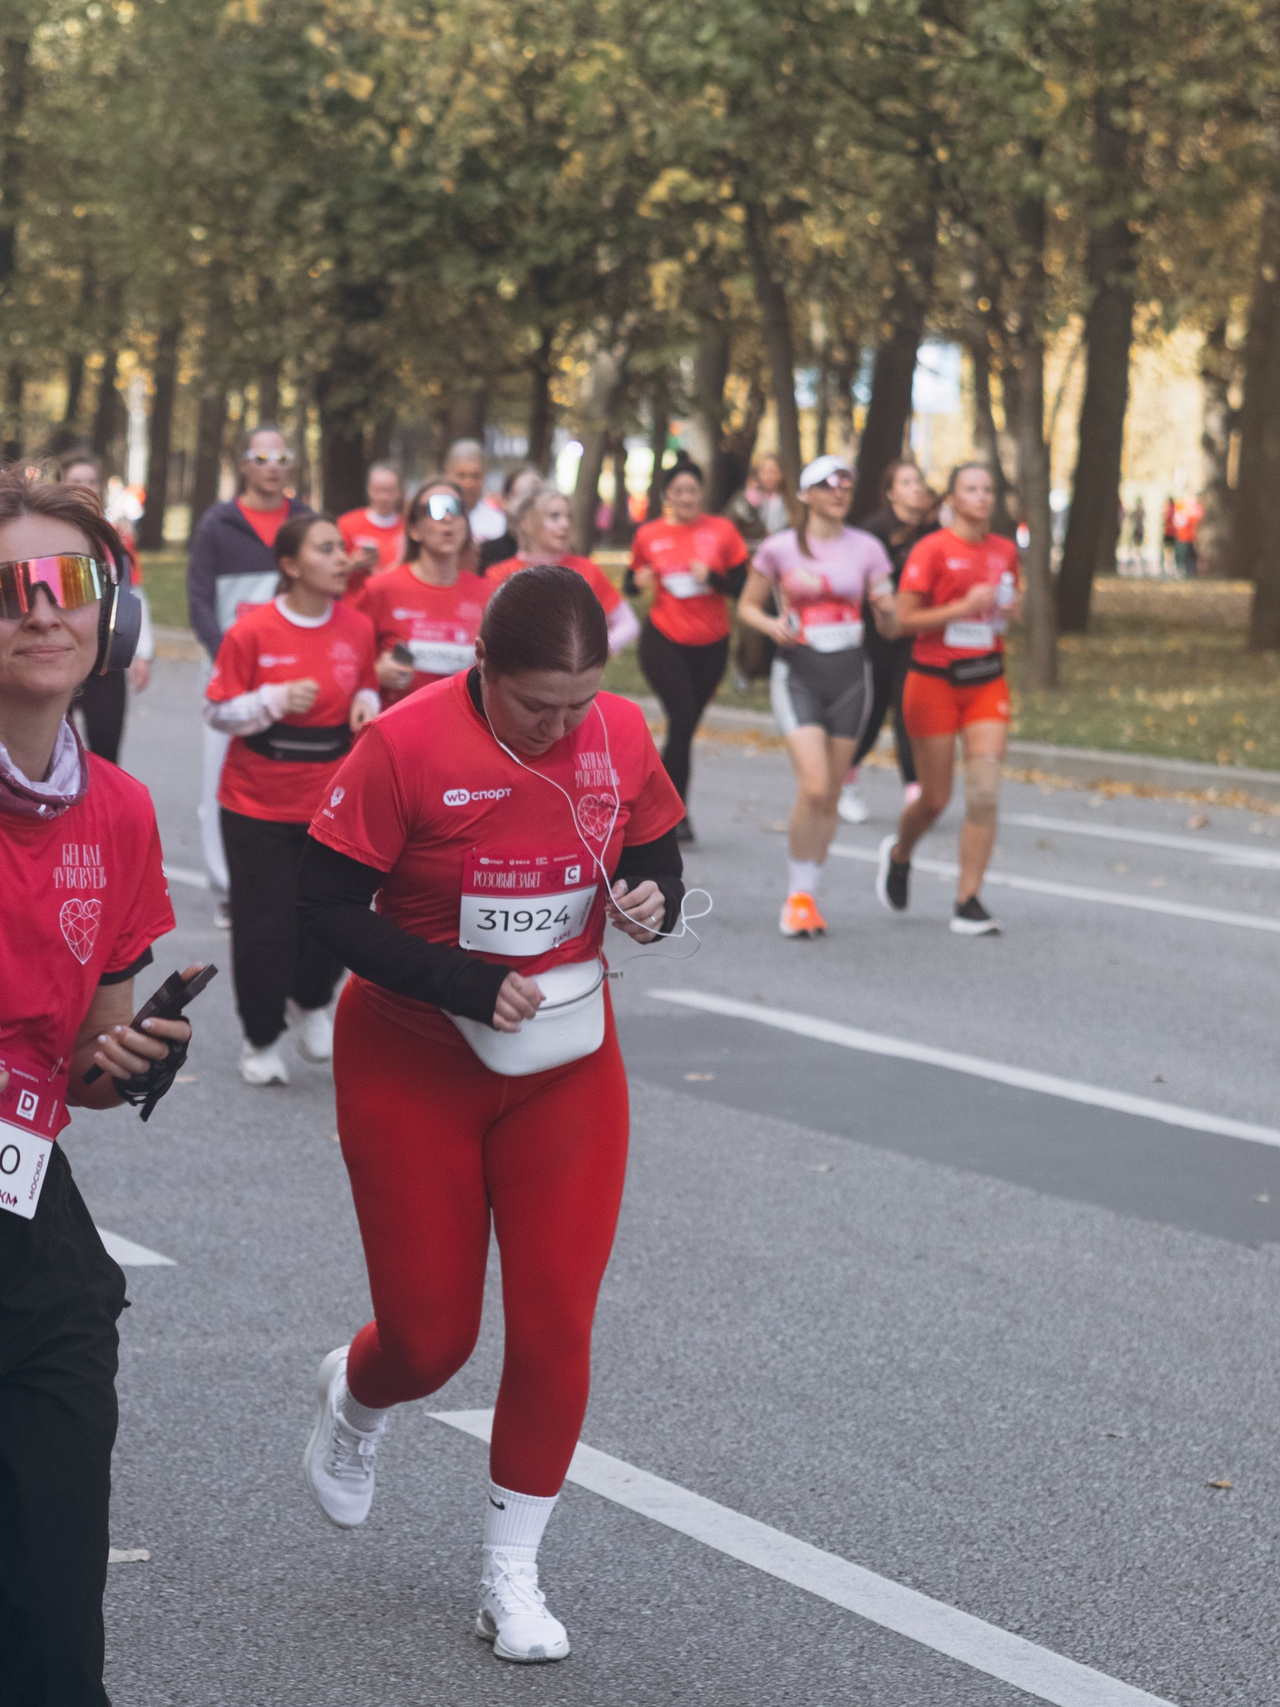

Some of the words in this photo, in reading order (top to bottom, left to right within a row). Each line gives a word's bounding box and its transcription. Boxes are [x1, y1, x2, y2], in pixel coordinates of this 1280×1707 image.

[473, 870, 516, 889] РОЗОВЫЙ
[516, 870, 542, 889] ЗАБЕГ
[476, 905, 571, 932] 31924
[20, 1092, 35, 1112] D
[28, 1153, 45, 1201] МОСКВА
